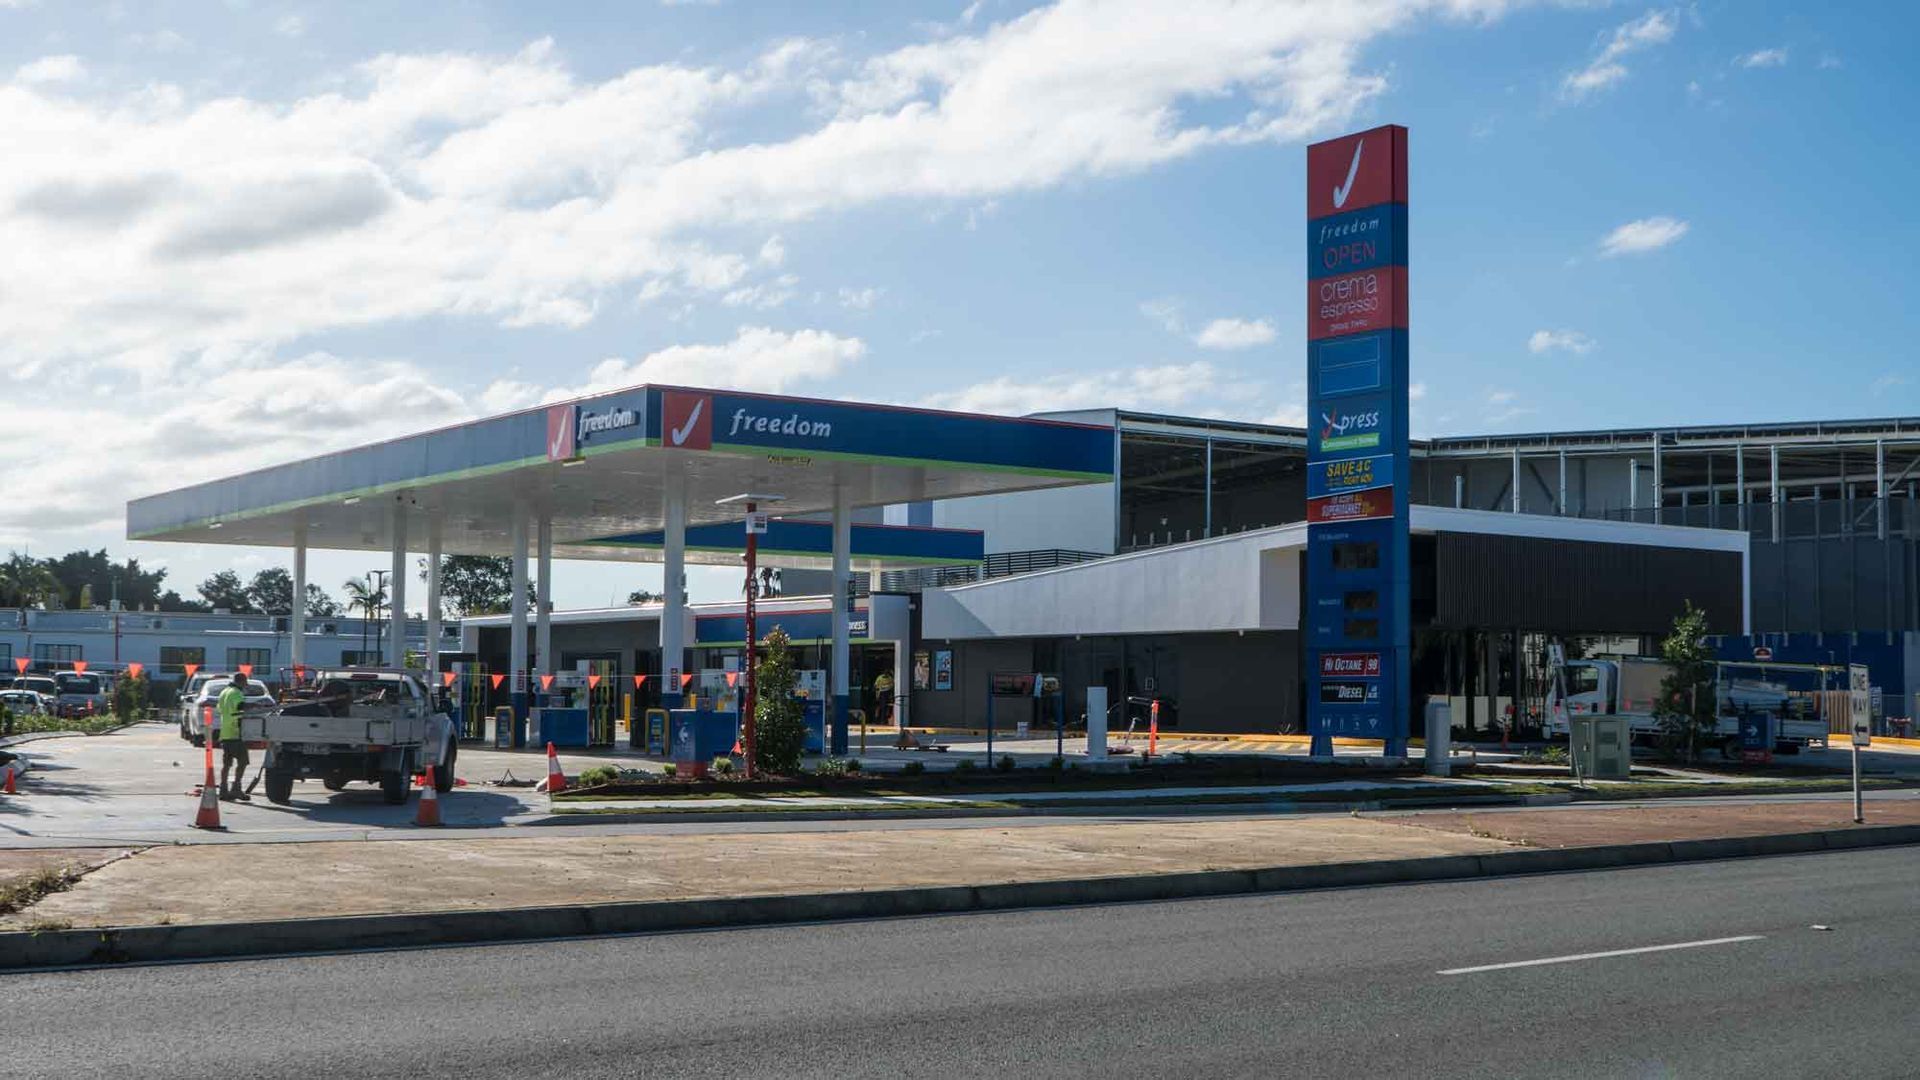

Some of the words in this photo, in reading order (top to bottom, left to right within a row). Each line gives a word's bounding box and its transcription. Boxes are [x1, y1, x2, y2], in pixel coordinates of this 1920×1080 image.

[1319, 218, 1379, 244] freedom
[1323, 241, 1375, 268] OPEN
[1320, 274, 1377, 302] crema
[1320, 298, 1378, 318] espresso
[577, 406, 632, 441] freedom
[729, 408, 832, 437] freedom
[1327, 461, 1355, 477] SAVE
[1335, 658, 1362, 671] OCTANE
[1338, 684, 1363, 698] DIESEL
[1852, 672, 1867, 691] ONE
[1852, 697, 1868, 716] WAY
